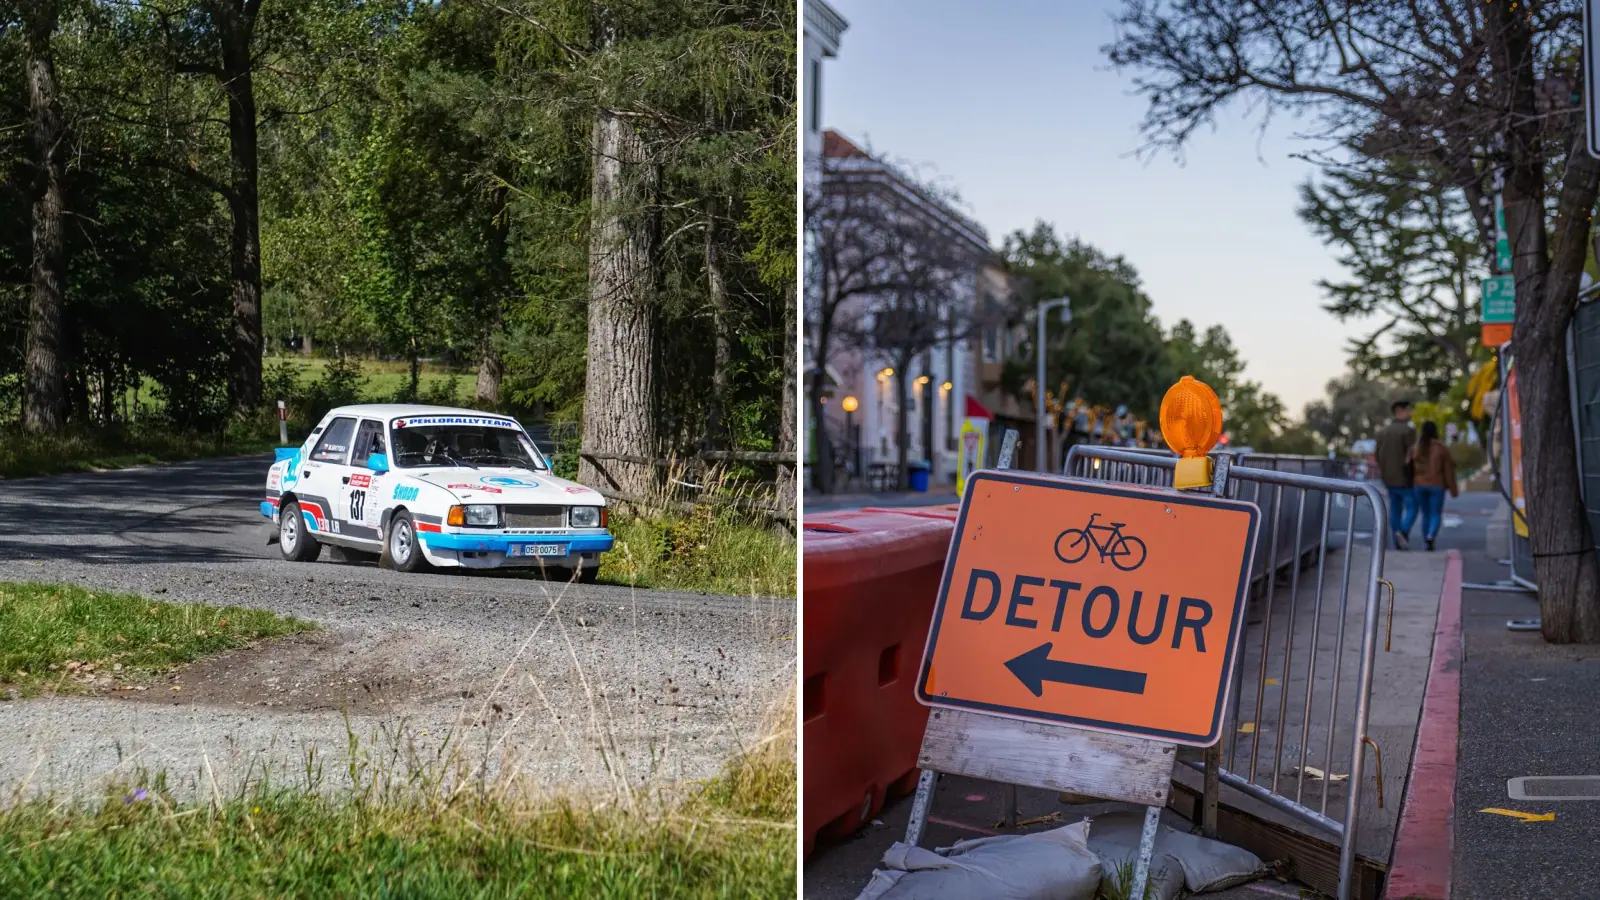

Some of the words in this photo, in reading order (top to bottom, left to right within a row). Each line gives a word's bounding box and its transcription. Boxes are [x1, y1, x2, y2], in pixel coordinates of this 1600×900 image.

[349, 489, 366, 521] 137
[392, 483, 420, 501] ŠKODA
[960, 568, 1213, 653] DETOUR
